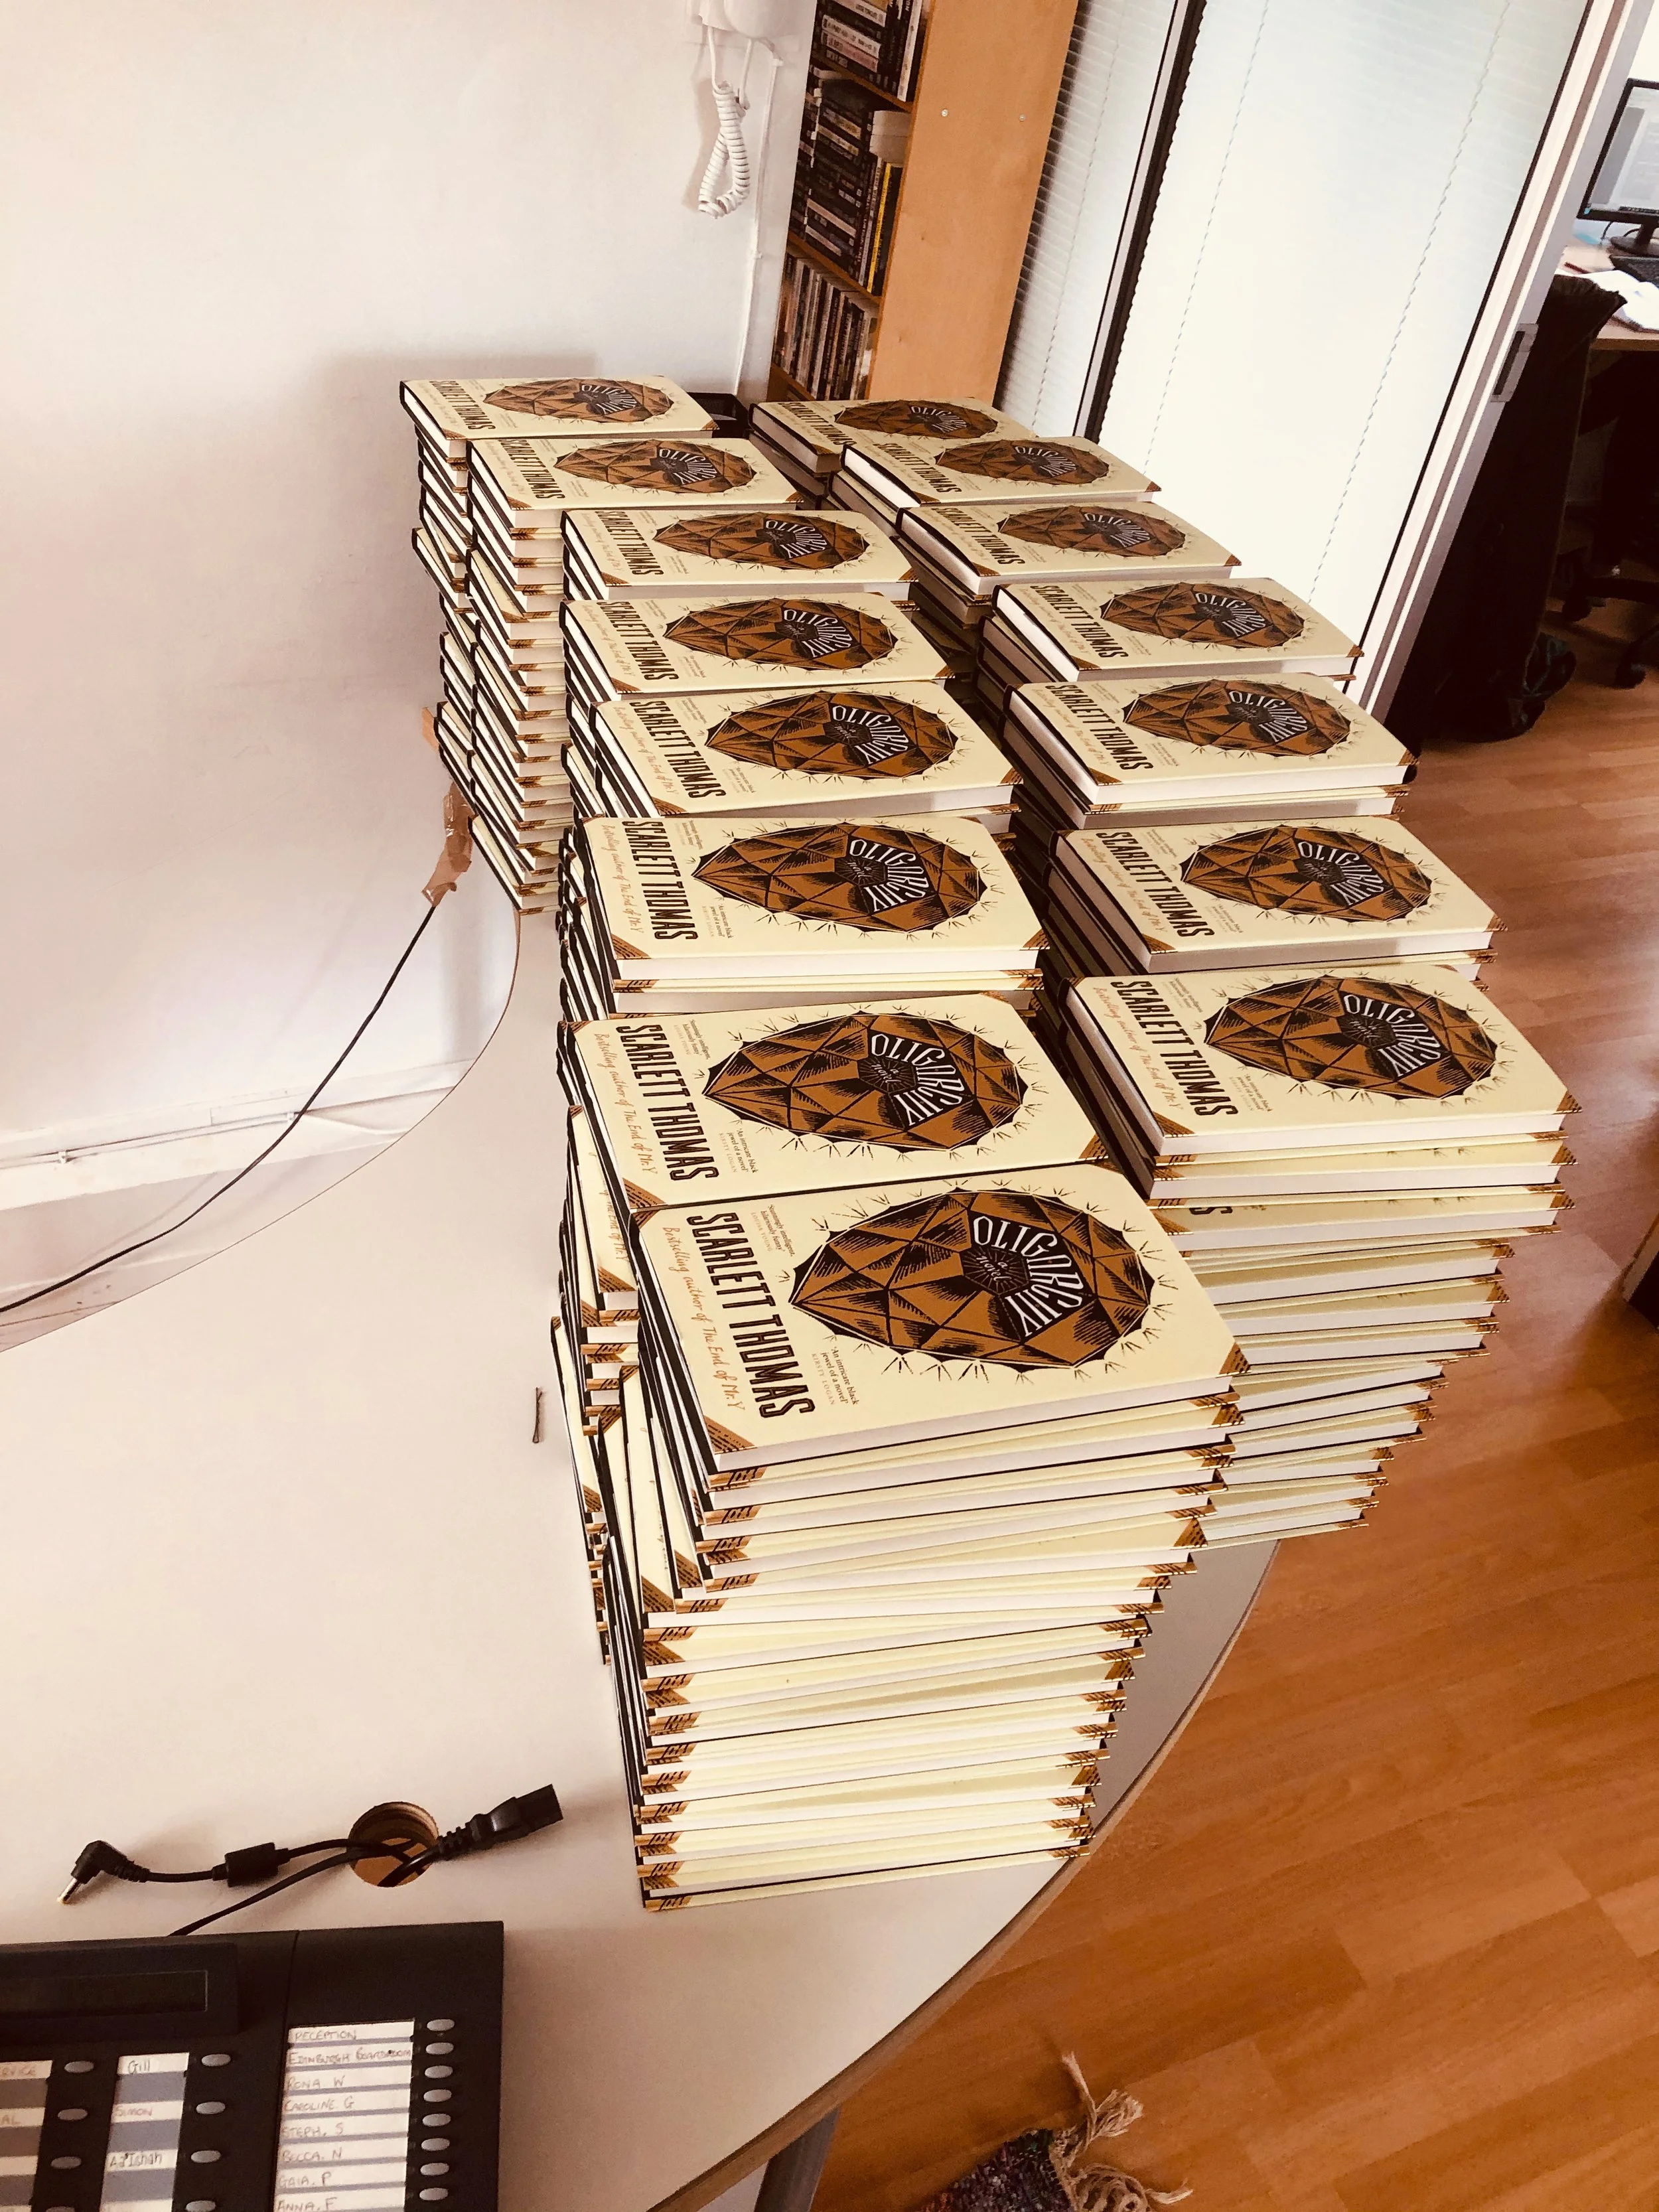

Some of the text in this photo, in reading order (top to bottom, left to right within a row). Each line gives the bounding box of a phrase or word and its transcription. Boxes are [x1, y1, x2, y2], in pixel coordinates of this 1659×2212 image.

[430, 378, 478, 404] SCARLETT
[451, 404, 496, 429] THOMAS
[777, 401, 830, 423] SCARLETT
[809, 423, 858, 446] THOMAS
[496, 438, 547, 469] SCARLETT
[875, 440, 932, 466] SCARLETT
[909, 465, 962, 492] THOMAS
[518, 468, 566, 498] THOMAS
[593, 508, 646, 542] SCARLETT
[763, 518, 828, 558] OLIGARCHY
[932, 504, 993, 534] SCARLETT
[969, 534, 1027, 563] THOMAS
[614, 542, 664, 575] THOMAS
[595, 598, 656, 638] SCARLETT
[781, 608, 853, 658] OLIGARCHY
[1031, 583, 1096, 621] SCARLETT
[1069, 621, 1129, 658] THOMAS
[1192, 592, 1266, 636] OLIGARCHY
[623, 639, 680, 680] THOMAS
[829, 705, 910, 764] OLIGARCHY
[1046, 682, 1116, 725] SCARLETT
[1087, 725, 1155, 770] THOMAS
[1226, 690, 1309, 742] OLIGARCHY
[627, 700, 697, 749] SCARLETT
[663, 749, 727, 799] THOMAS
[621, 820, 697, 939] SCARLETT THOMAS
[847, 838, 930, 912] OLIGARCHY
[1094, 831, 1174, 883] SCARLETT
[1143, 885, 1216, 938] THOMAS
[1295, 841, 1384, 905] OLIGARCHY
[593, 1033, 618, 1070] Bestselling
[1110, 980, 1194, 1045] SCARLETT
[1159, 1049, 1239, 1117] THOMAS
[1340, 994, 1441, 1077] OLIGARCHY
[609, 1071, 628, 1098] author
[867, 1033, 966, 1126] OLIGARCHY
[870, 1063, 902, 1083] novel
[615, 1024, 719, 1181] SCARLETT THOMAS
[623, 1110, 636, 1124] The
[626, 1124, 646, 1141] End
[630, 1143, 652, 1151] of
[661, 1226, 691, 1273] Bestselling
[975, 1255, 1012, 1281] novel
[682, 1276, 705, 1311] author
[969, 1215, 1084, 1337] OLIGARCHY
[685, 1211, 816, 1418] SCARLETT THOMAS
[691, 1312, 713, 1322] of
[702, 1326, 717, 1344] The
[707, 1346, 731, 1367] End
[713, 1370, 737, 1381] of
[333, 2075, 345, 2087] W
[344, 2095, 354, 2109] G
[335, 2122, 344, 2134] S
[332, 2147, 342, 2159] N
[322, 2171, 332, 2185] P
